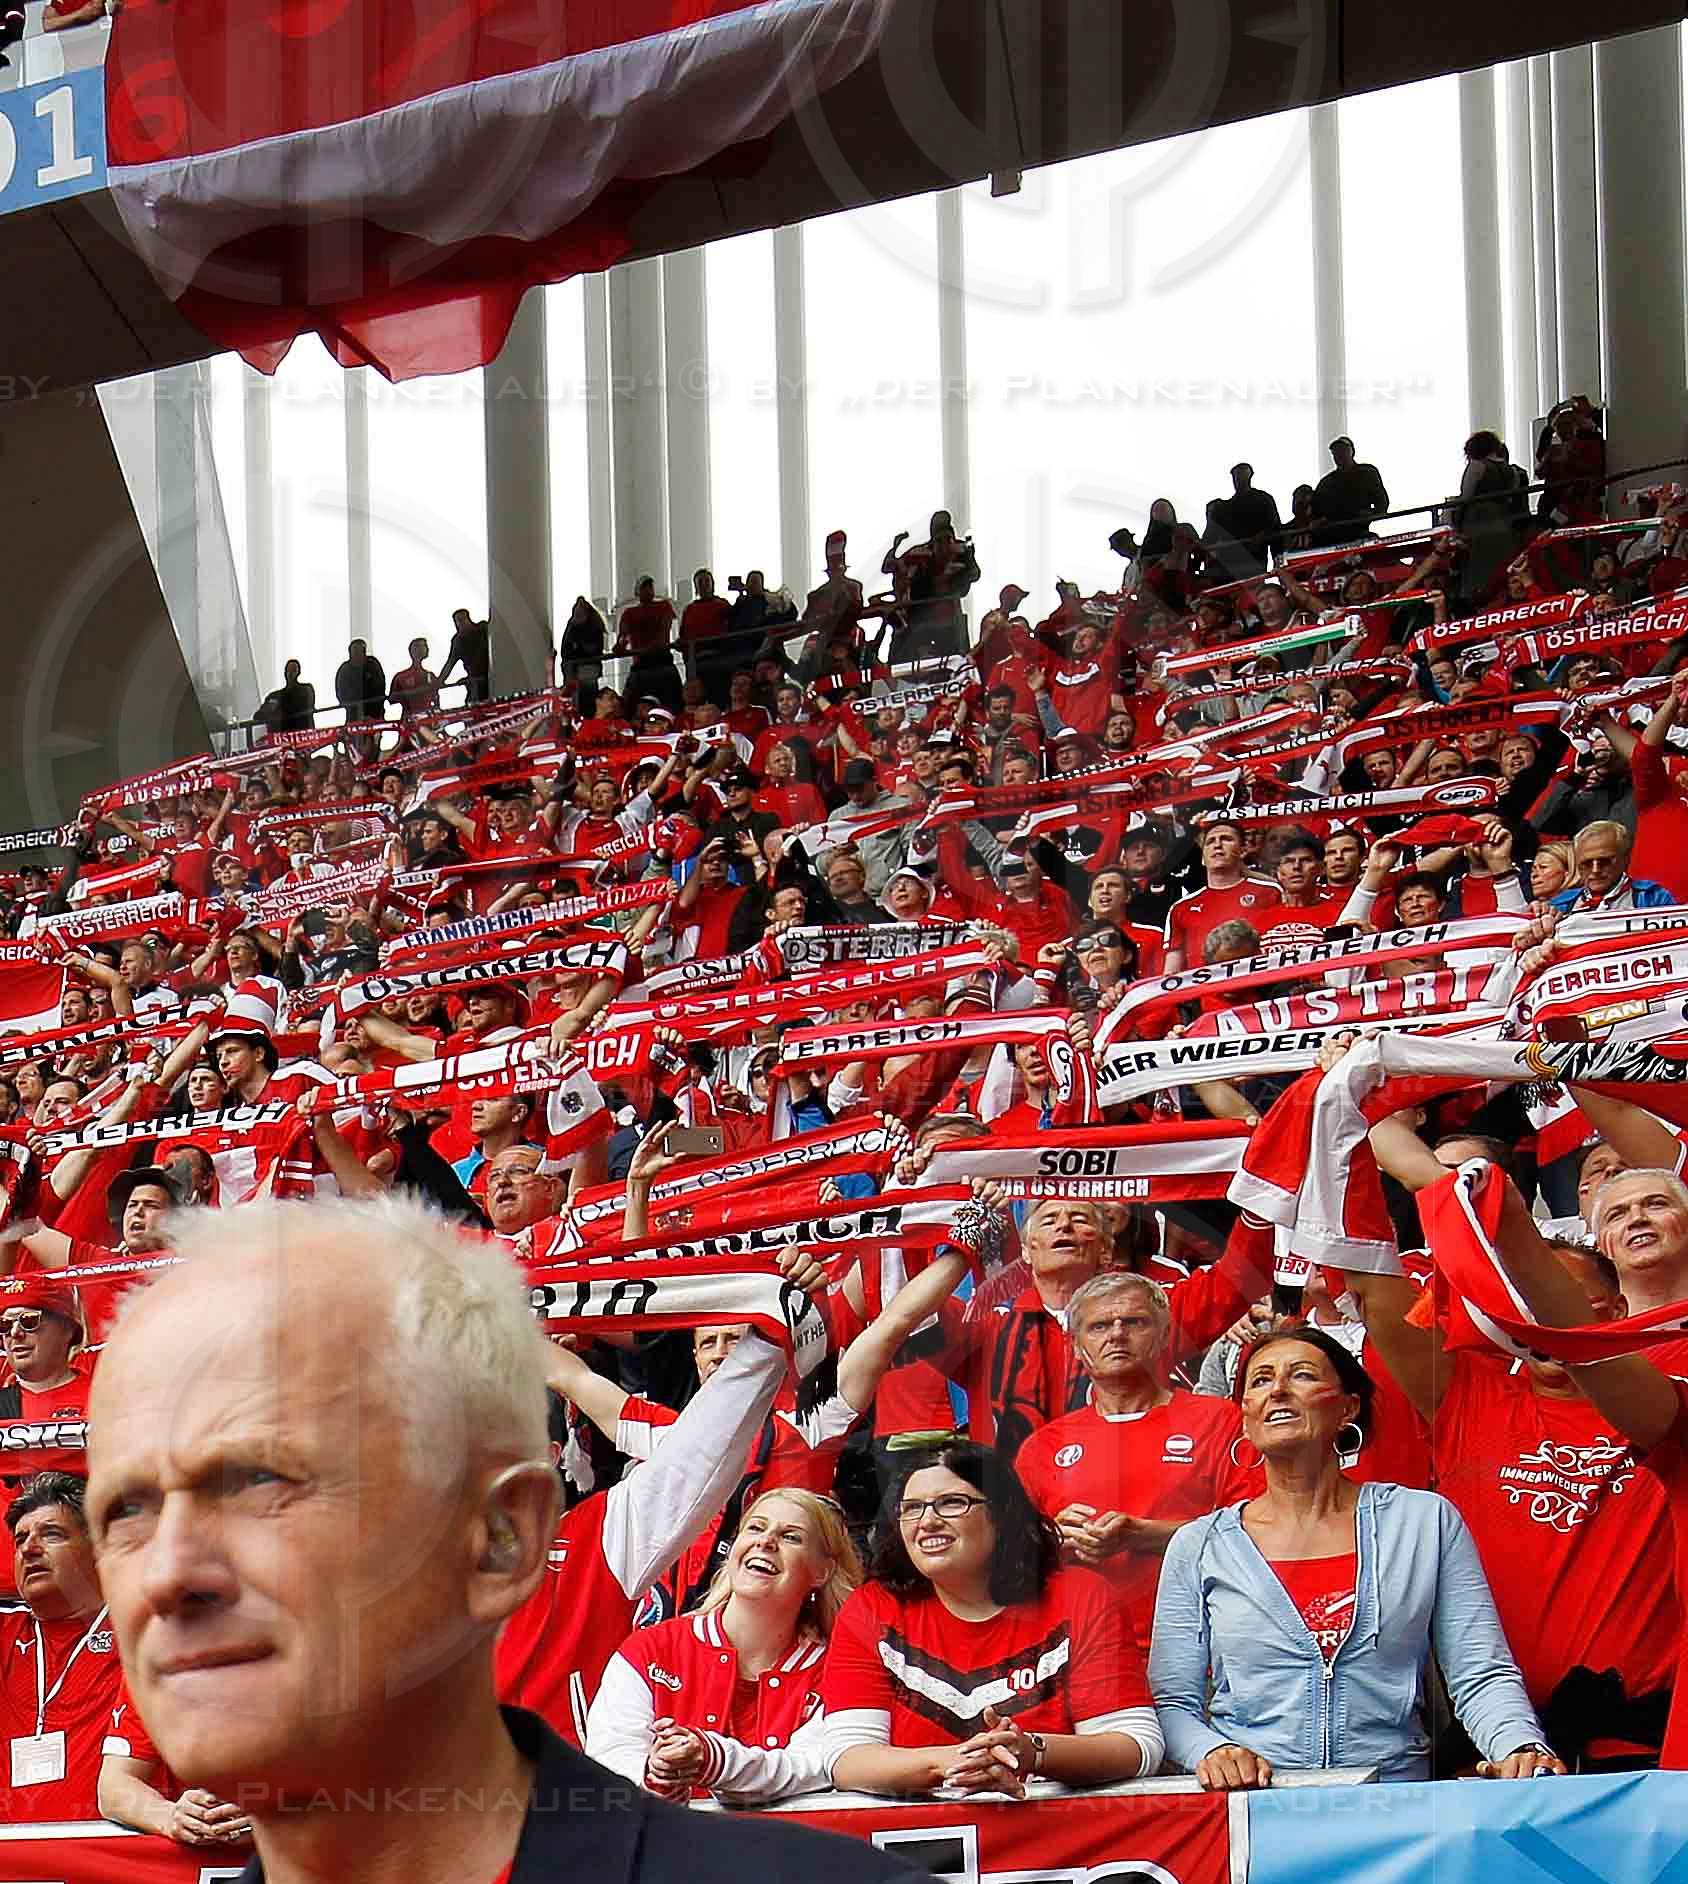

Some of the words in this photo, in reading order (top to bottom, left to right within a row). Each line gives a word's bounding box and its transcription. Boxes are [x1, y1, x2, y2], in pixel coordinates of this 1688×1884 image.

[1434, 601, 1567, 638] ÖSTERREICH
[852, 681, 968, 715] ÖSTERREICH
[122, 775, 214, 807] AUSTRIA
[1216, 791, 1376, 820] ÖSTERREICH
[69, 900, 183, 938] ÖSTERREICH
[404, 910, 534, 950] FRANKREICH
[361, 940, 621, 1003] ÖSTERREICH
[1159, 921, 1449, 993] ÖSTERREICH
[1588, 998, 1649, 1028] FAN
[1037, 1149, 1118, 1178] SOBI
[1030, 1177, 1150, 1199] ÖSTERREICH
[1009, 1668, 1035, 1690] 10
